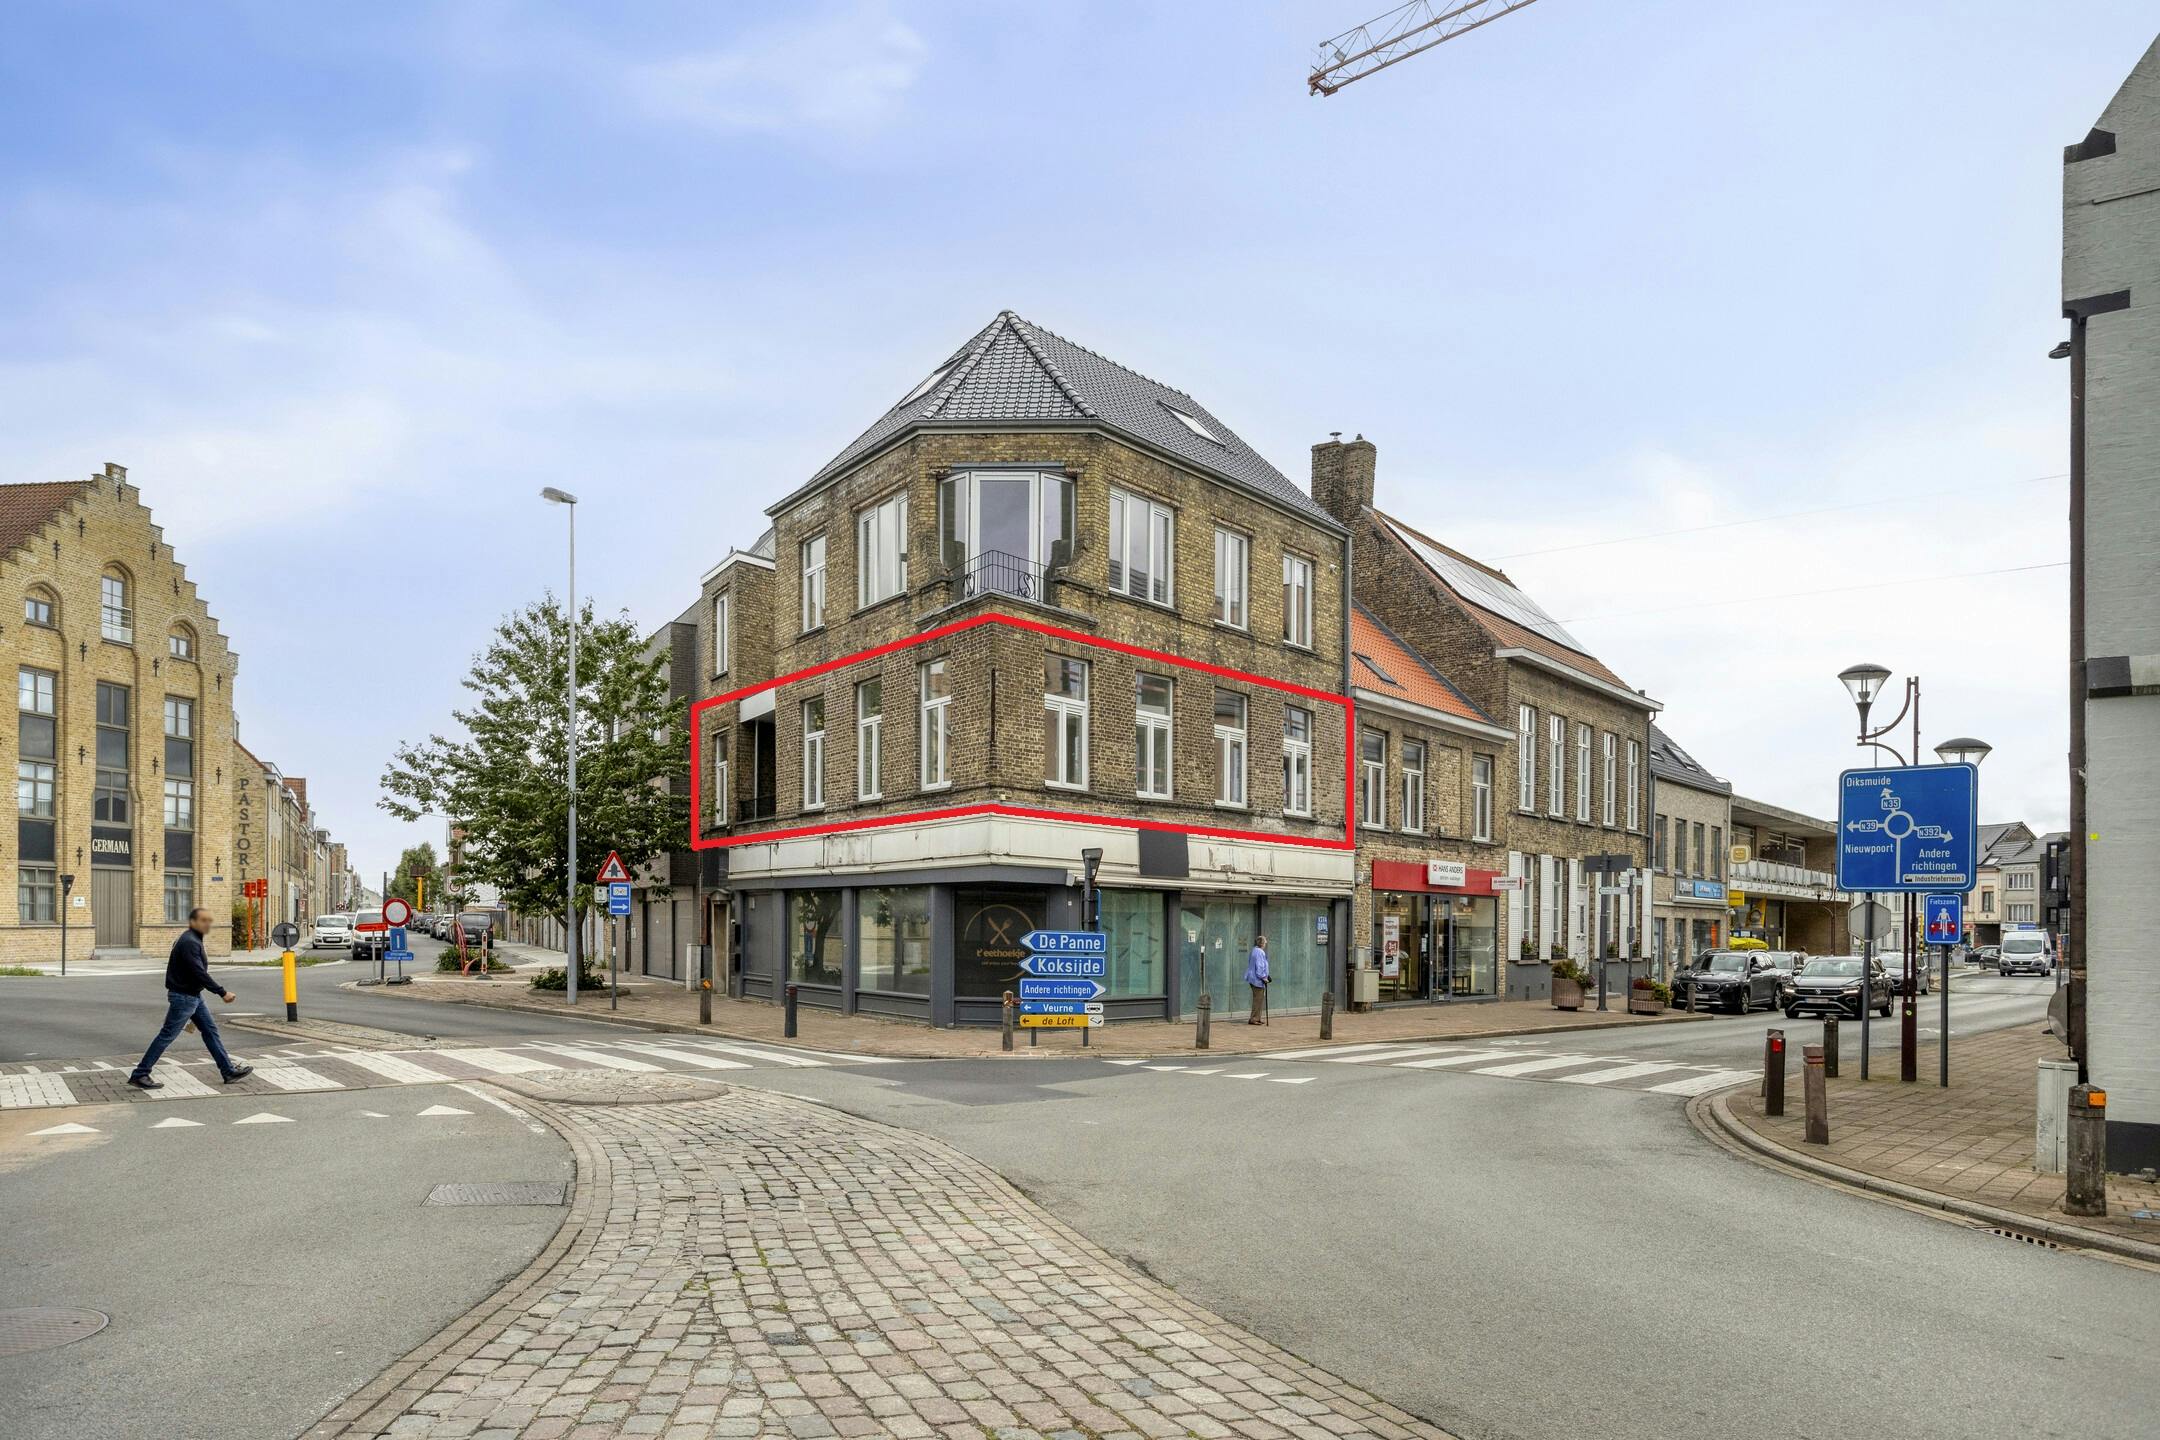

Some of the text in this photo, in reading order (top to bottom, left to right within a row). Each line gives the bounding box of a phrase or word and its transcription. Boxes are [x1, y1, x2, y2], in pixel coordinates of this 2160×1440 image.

[1846, 775, 1891, 787] Diksmuide
[1883, 799, 1899, 809] N35
[1861, 823, 1876, 831] N39
[1919, 827, 1939, 837] N392
[92, 838, 130, 855] GERMANA
[1845, 843, 1894, 855] Nieuwpoort
[1919, 848, 1950, 858] Andere
[1911, 861, 1957, 873] richtingen
[1039, 934, 1101, 950] De Panne
[1038, 958, 1100, 976] Koksijde
[1024, 985, 1091, 996] Andere richtingen
[1043, 1003, 1074, 1013] Veurne
[1042, 1016, 1075, 1026] de Loft
